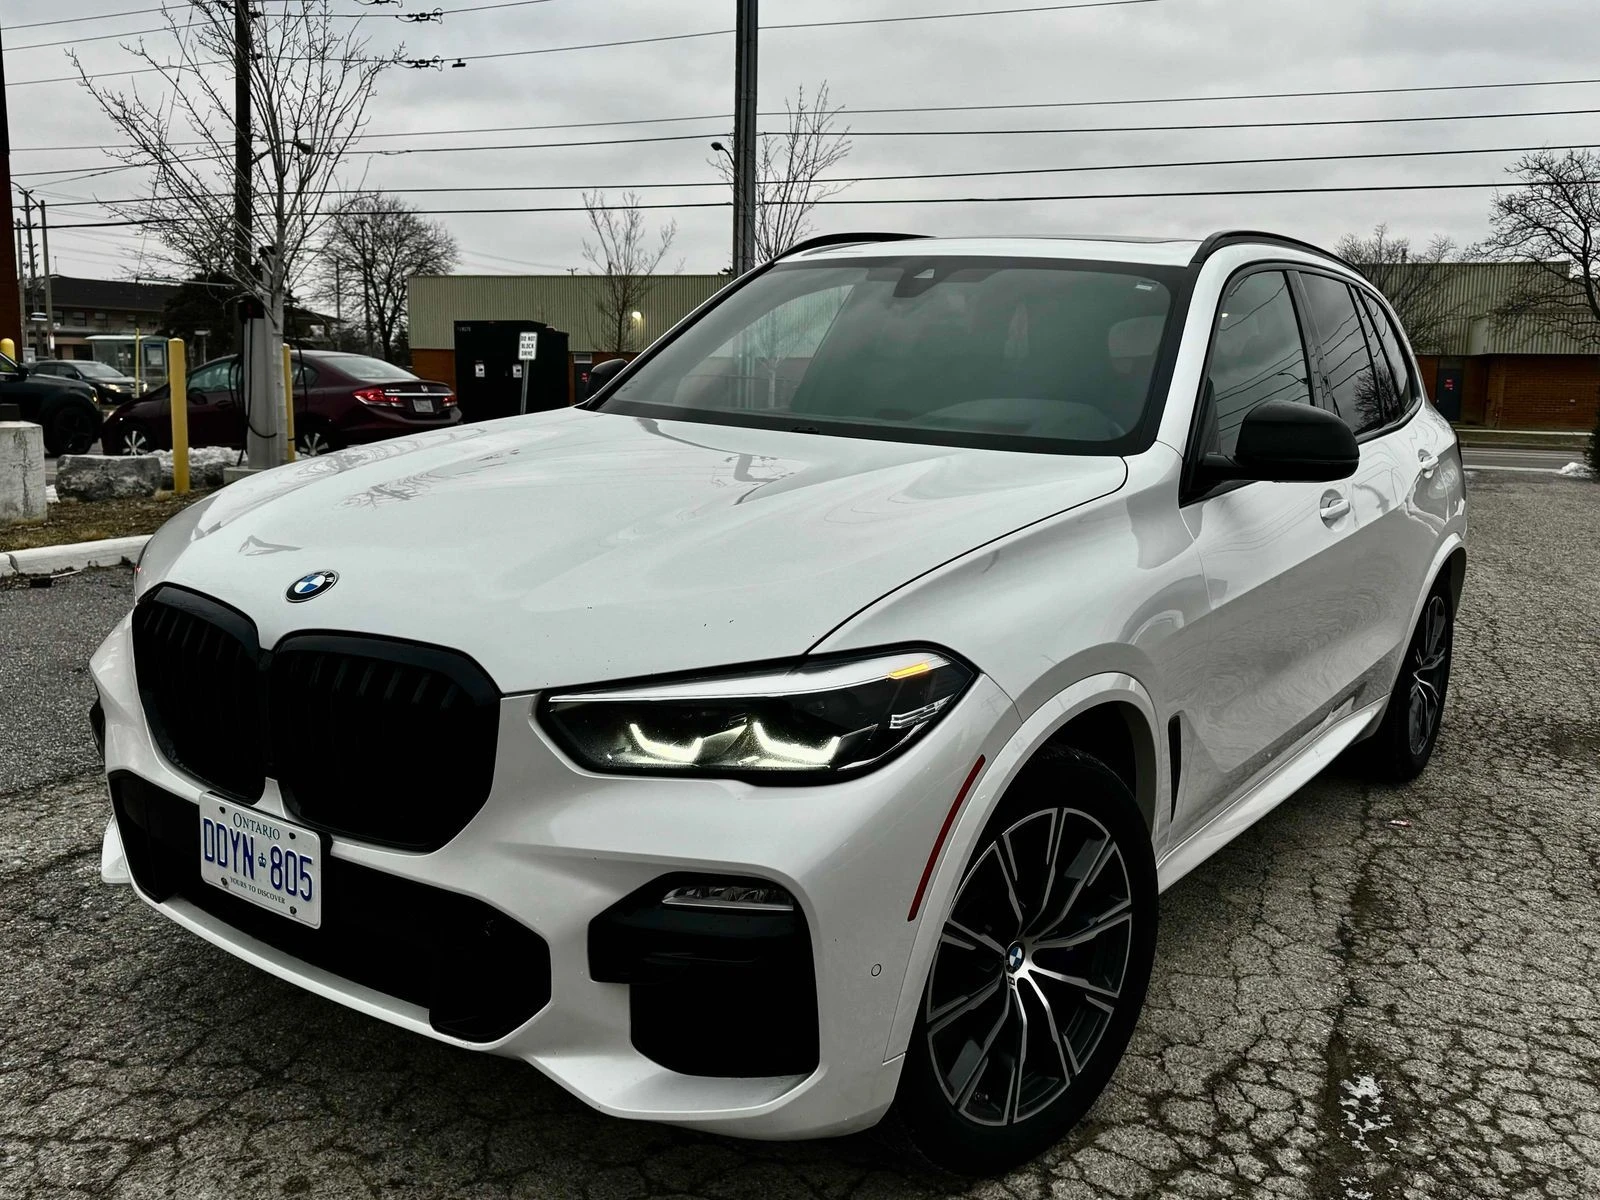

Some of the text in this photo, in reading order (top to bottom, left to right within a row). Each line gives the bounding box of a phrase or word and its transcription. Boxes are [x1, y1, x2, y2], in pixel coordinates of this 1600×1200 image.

[233, 812, 280, 840] ONTARIO
[203, 817, 313, 902] DDYN 805
[230, 876, 286, 904] YOURS TO DISCOVER
